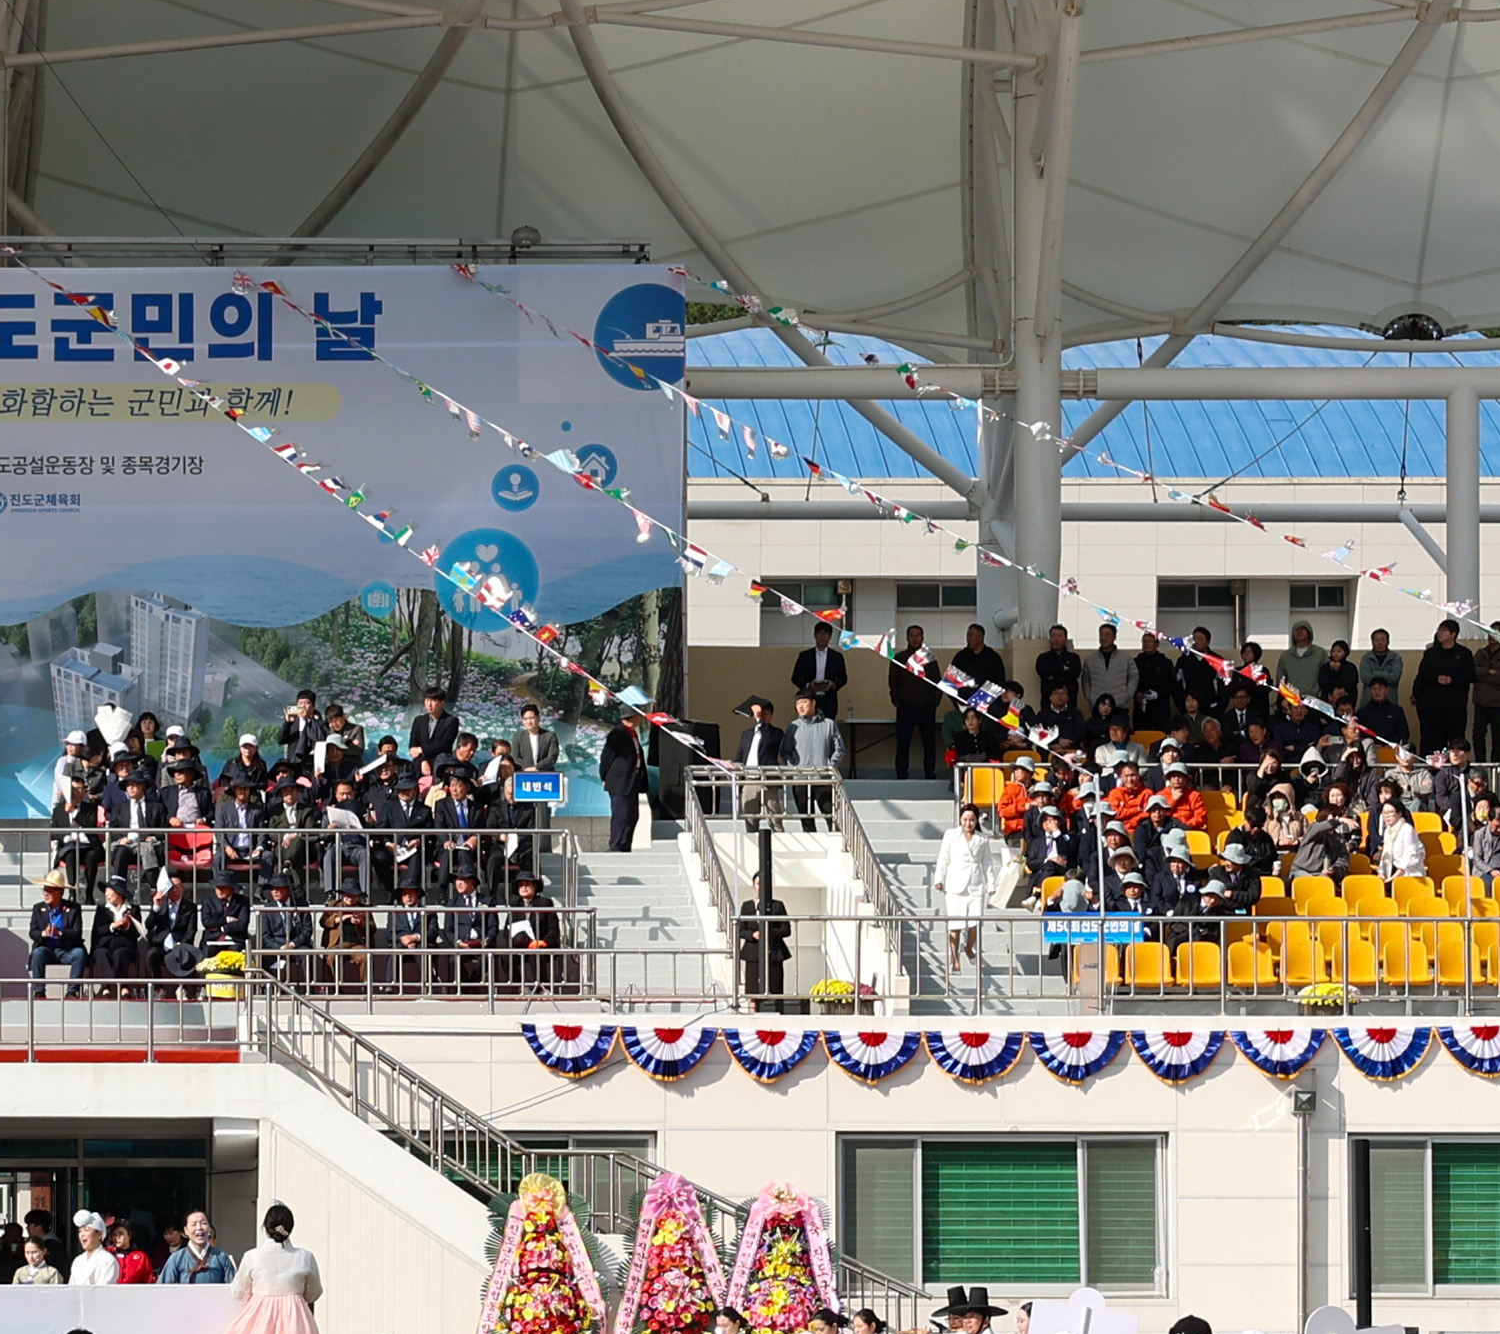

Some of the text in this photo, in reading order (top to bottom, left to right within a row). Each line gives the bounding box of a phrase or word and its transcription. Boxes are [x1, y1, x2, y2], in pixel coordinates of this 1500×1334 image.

[313, 292, 383, 361] 날
[0, 387, 115, 418] 화합하는
[128, 387, 209, 418] 군민과
[227, 387, 294, 417] 함께!
[100, 455, 116, 475] 및
[121, 455, 204, 475] 종목경기장
[9, 493, 81, 506] 진도군체육회
[521, 781, 553, 793] 내빈석
